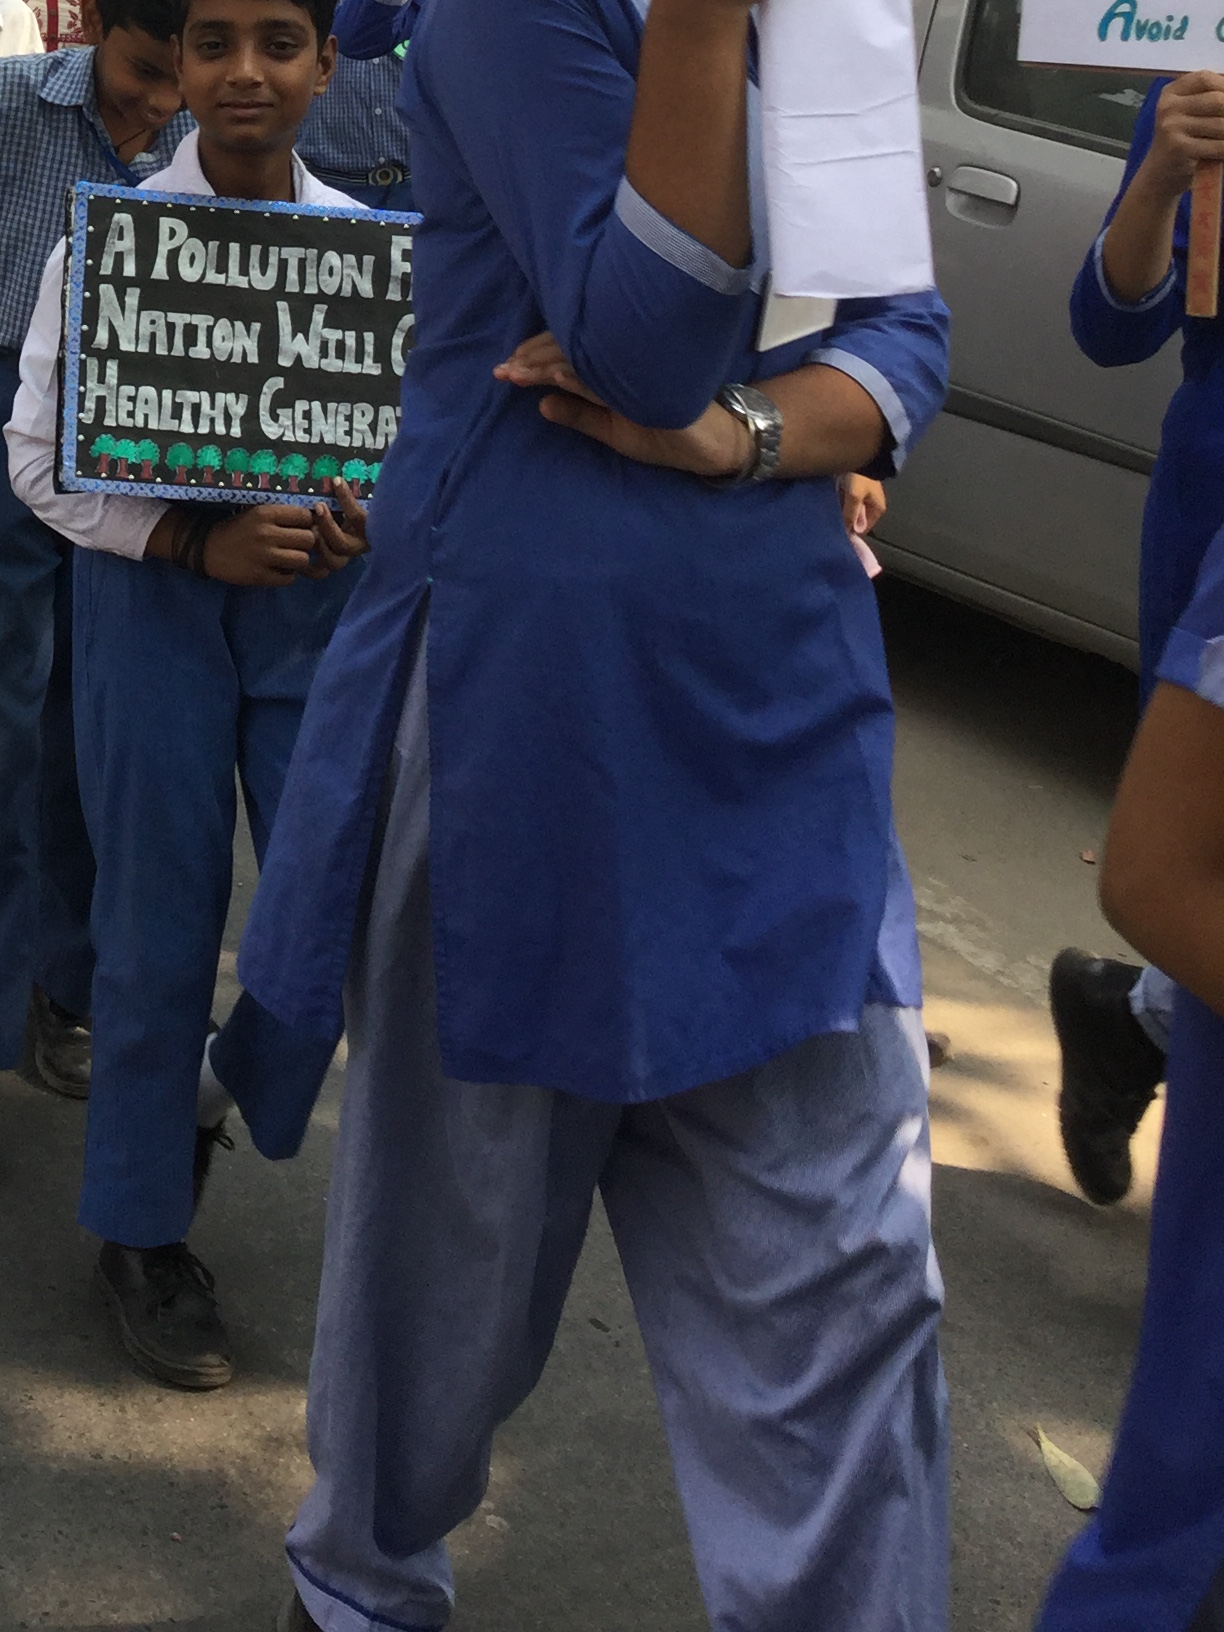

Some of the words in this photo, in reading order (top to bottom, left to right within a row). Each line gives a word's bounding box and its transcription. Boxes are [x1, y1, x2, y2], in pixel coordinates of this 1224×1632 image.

[99, 212, 137, 278] A
[150, 216, 376, 299] POLLUTION
[90, 283, 261, 364] NATION
[276, 300, 382, 376] WILL
[82, 356, 249, 439] HEALTHY
[259, 376, 402, 449] GENERA
